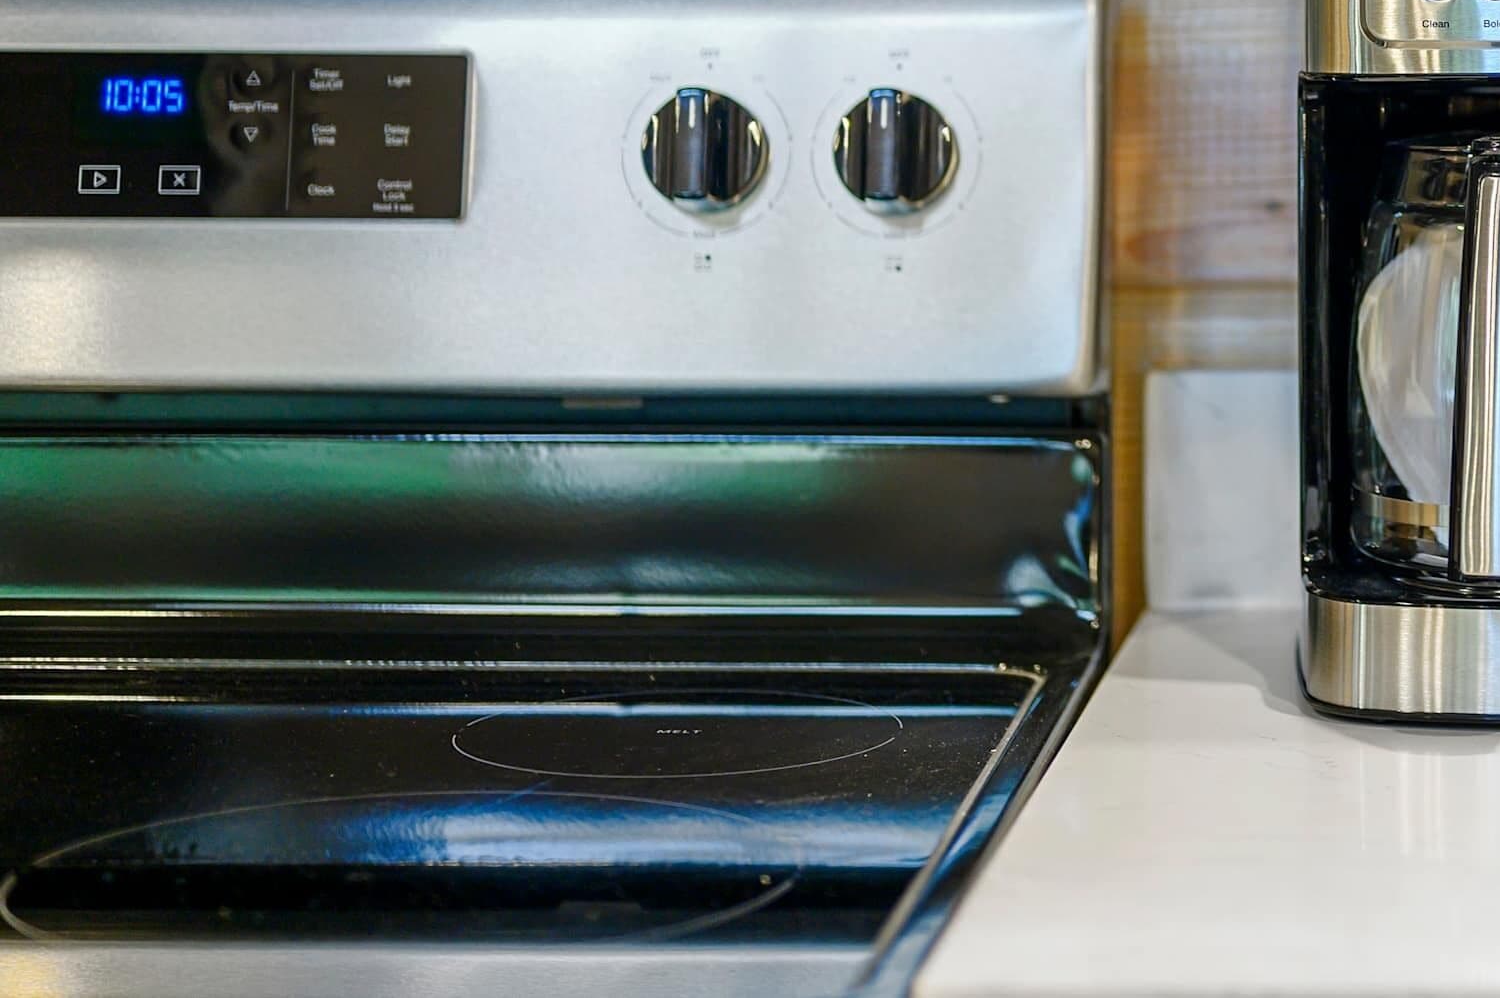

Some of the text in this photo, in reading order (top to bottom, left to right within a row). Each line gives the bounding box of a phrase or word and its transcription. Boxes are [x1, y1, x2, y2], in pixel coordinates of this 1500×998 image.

[1422, 18, 1450, 29] Clean
[387, 74, 412, 87] Light
[104, 78, 184, 113] 10:05
[228, 100, 279, 113] Temp/Time
[307, 183, 335, 196] Clock
